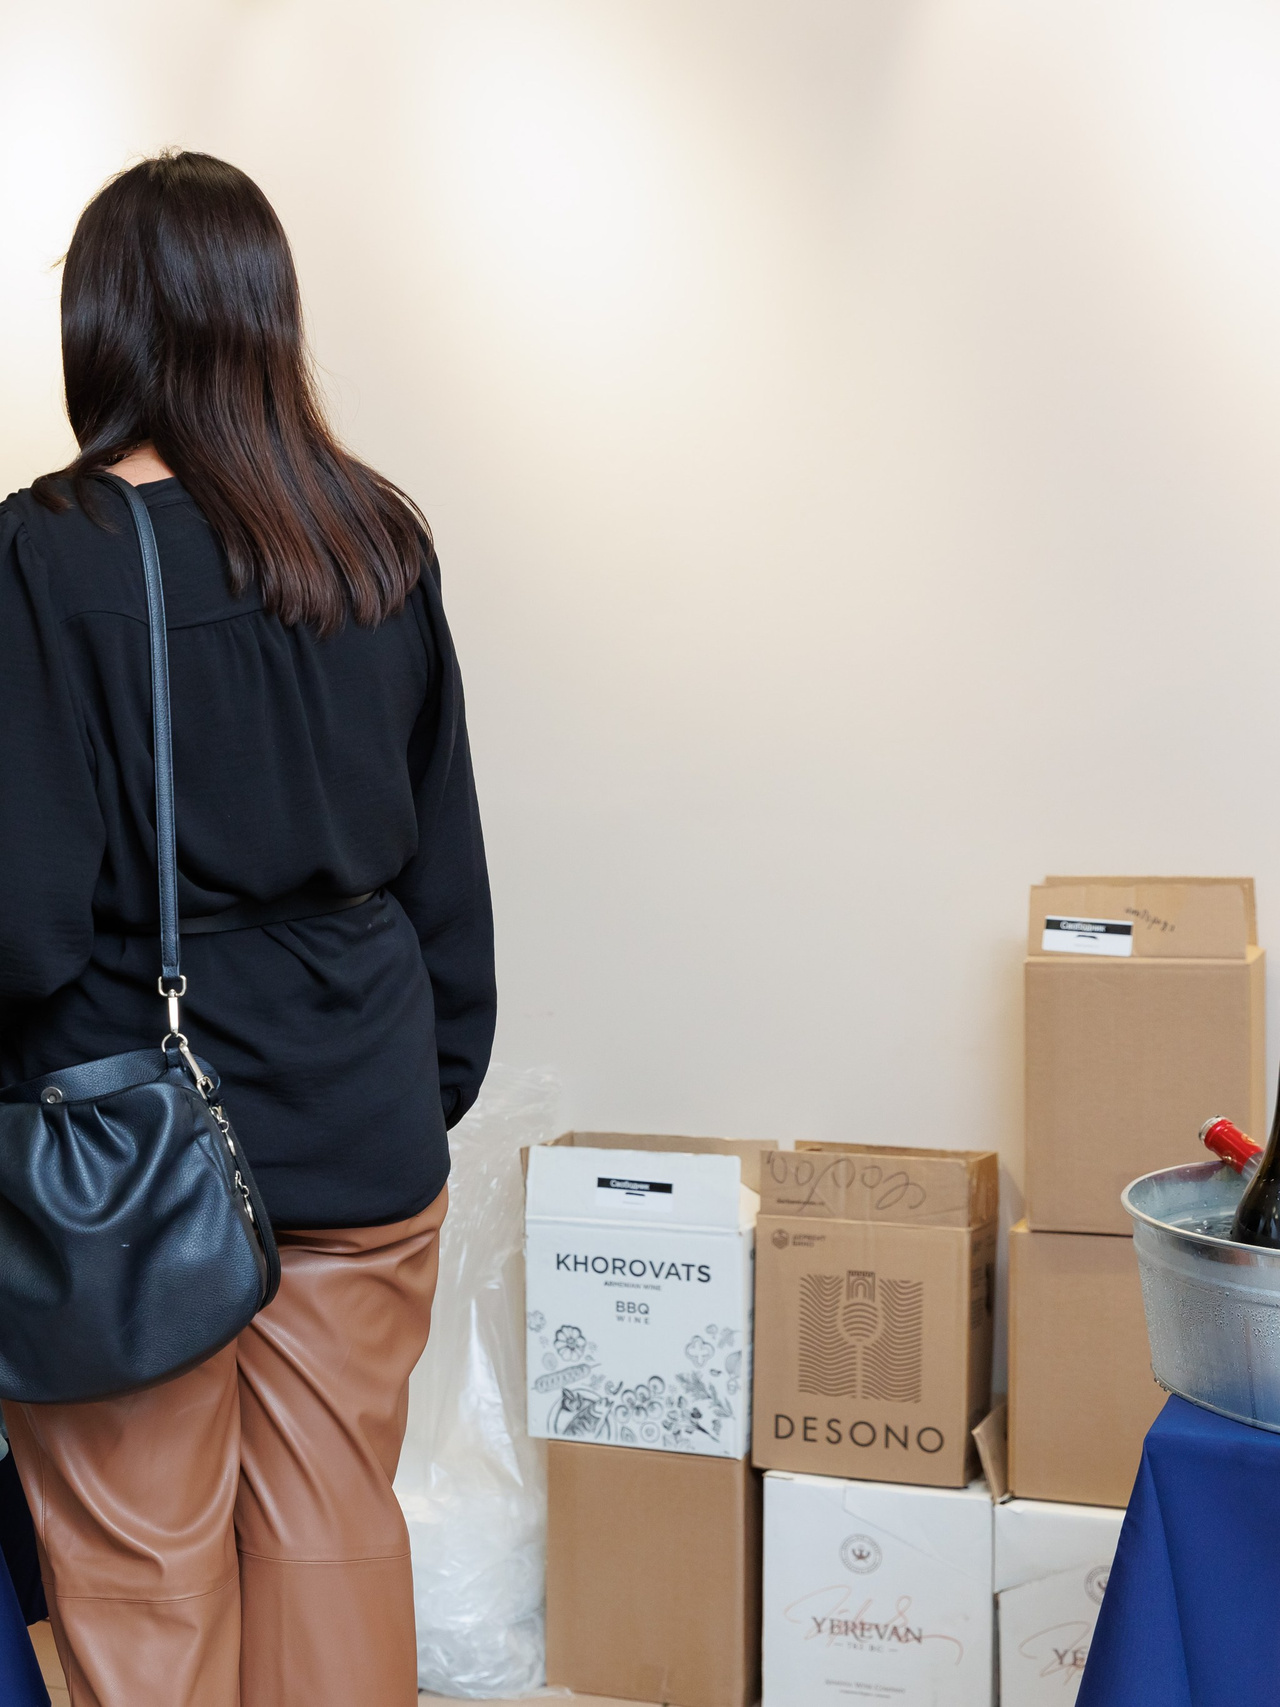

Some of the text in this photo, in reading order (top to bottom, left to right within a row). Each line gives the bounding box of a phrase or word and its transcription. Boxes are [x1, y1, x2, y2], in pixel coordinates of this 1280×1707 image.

[556, 1253, 712, 1284] KHOROVATS
[615, 1300, 651, 1315] BBQ
[615, 1315, 651, 1325] WINE
[774, 1413, 945, 1454] DESONO
[811, 1616, 923, 1644] YEREVAN
